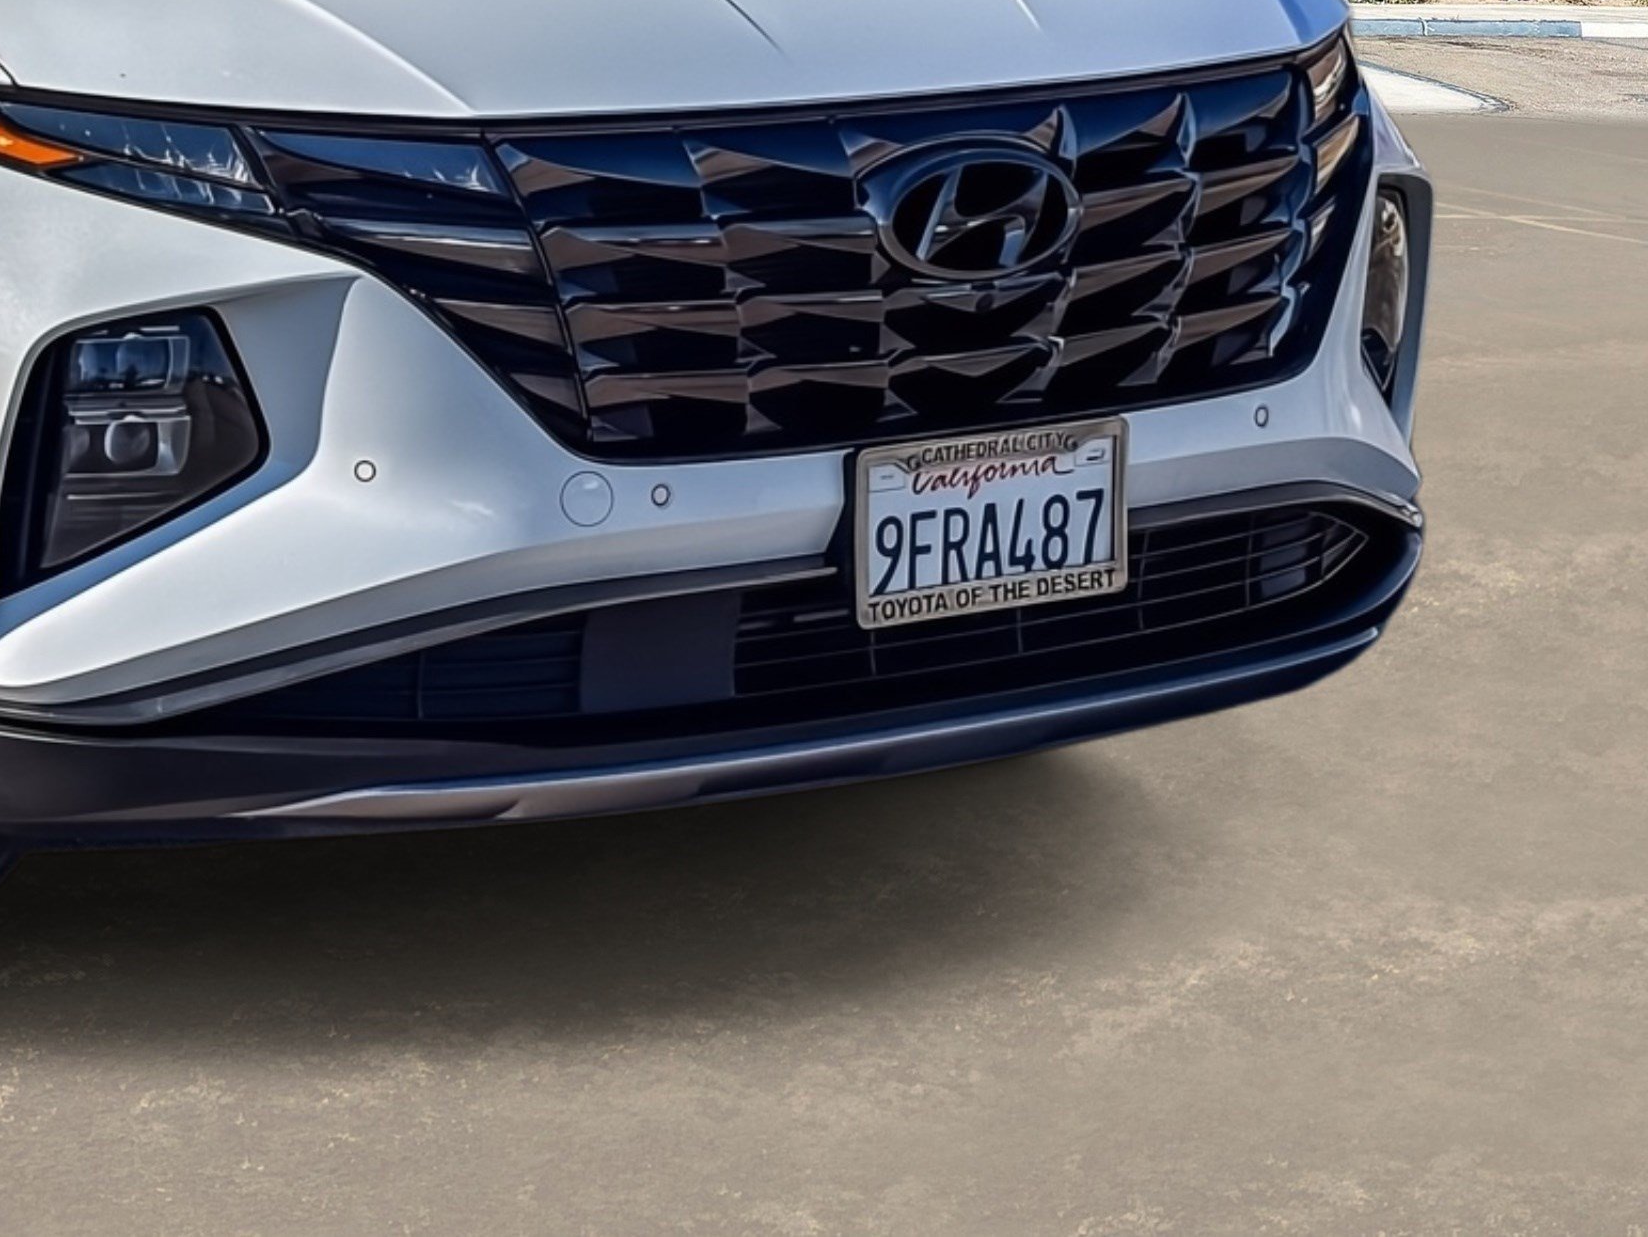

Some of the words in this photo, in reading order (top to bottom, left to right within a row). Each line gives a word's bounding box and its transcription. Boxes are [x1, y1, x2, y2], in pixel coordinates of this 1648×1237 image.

[921, 437, 1021, 463] CATHEDRAL
[1026, 432, 1066, 451] CITY
[912, 456, 1075, 499] California
[869, 488, 1104, 597] 9FRA487
[868, 593, 948, 622] TOYOTA
[956, 589, 982, 609] OF
[989, 578, 1031, 602] THE
[1037, 568, 1117, 596] DESERT
